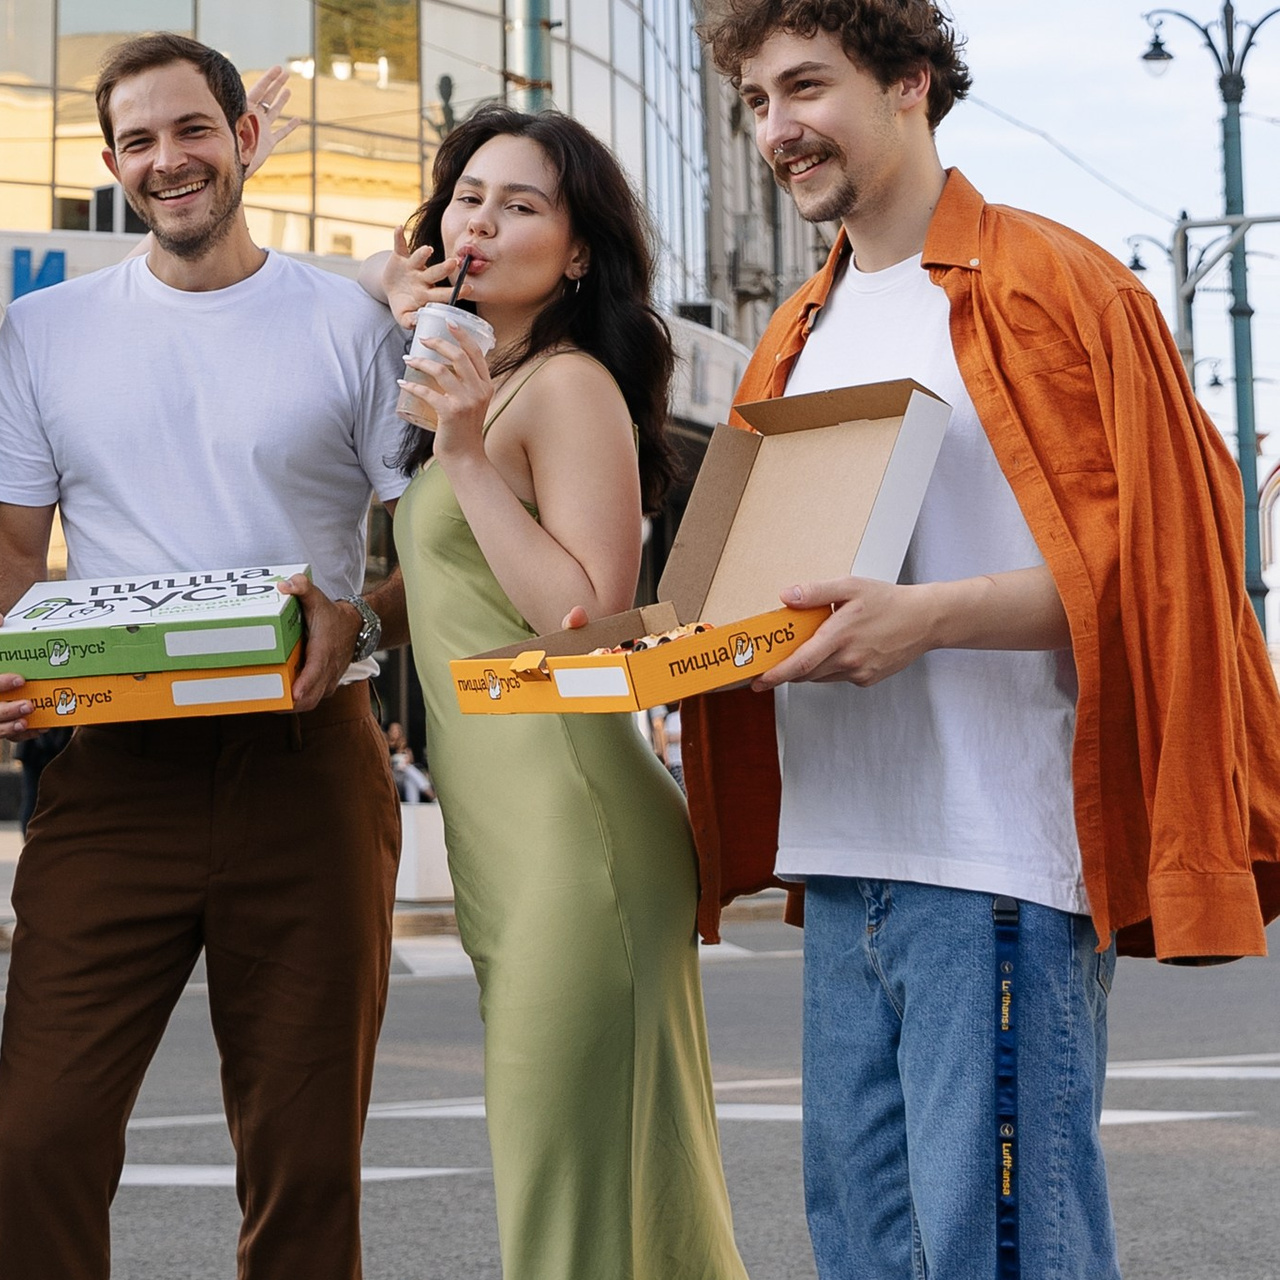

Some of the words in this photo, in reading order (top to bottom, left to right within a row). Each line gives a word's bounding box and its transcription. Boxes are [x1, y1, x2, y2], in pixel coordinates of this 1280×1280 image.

[89, 568, 273, 596] пицца
[88, 583, 275, 613] гусь
[72, 642, 105, 658] гусь
[669, 646, 731, 677] пицца
[754, 625, 795, 653] гусь
[78, 691, 112, 707] гусь
[458, 679, 488, 693] пицца
[500, 676, 521, 693] гусь
[1001, 980, 1012, 1031] Lufthansa
[1001, 1142, 1013, 1196] Lufthansa
